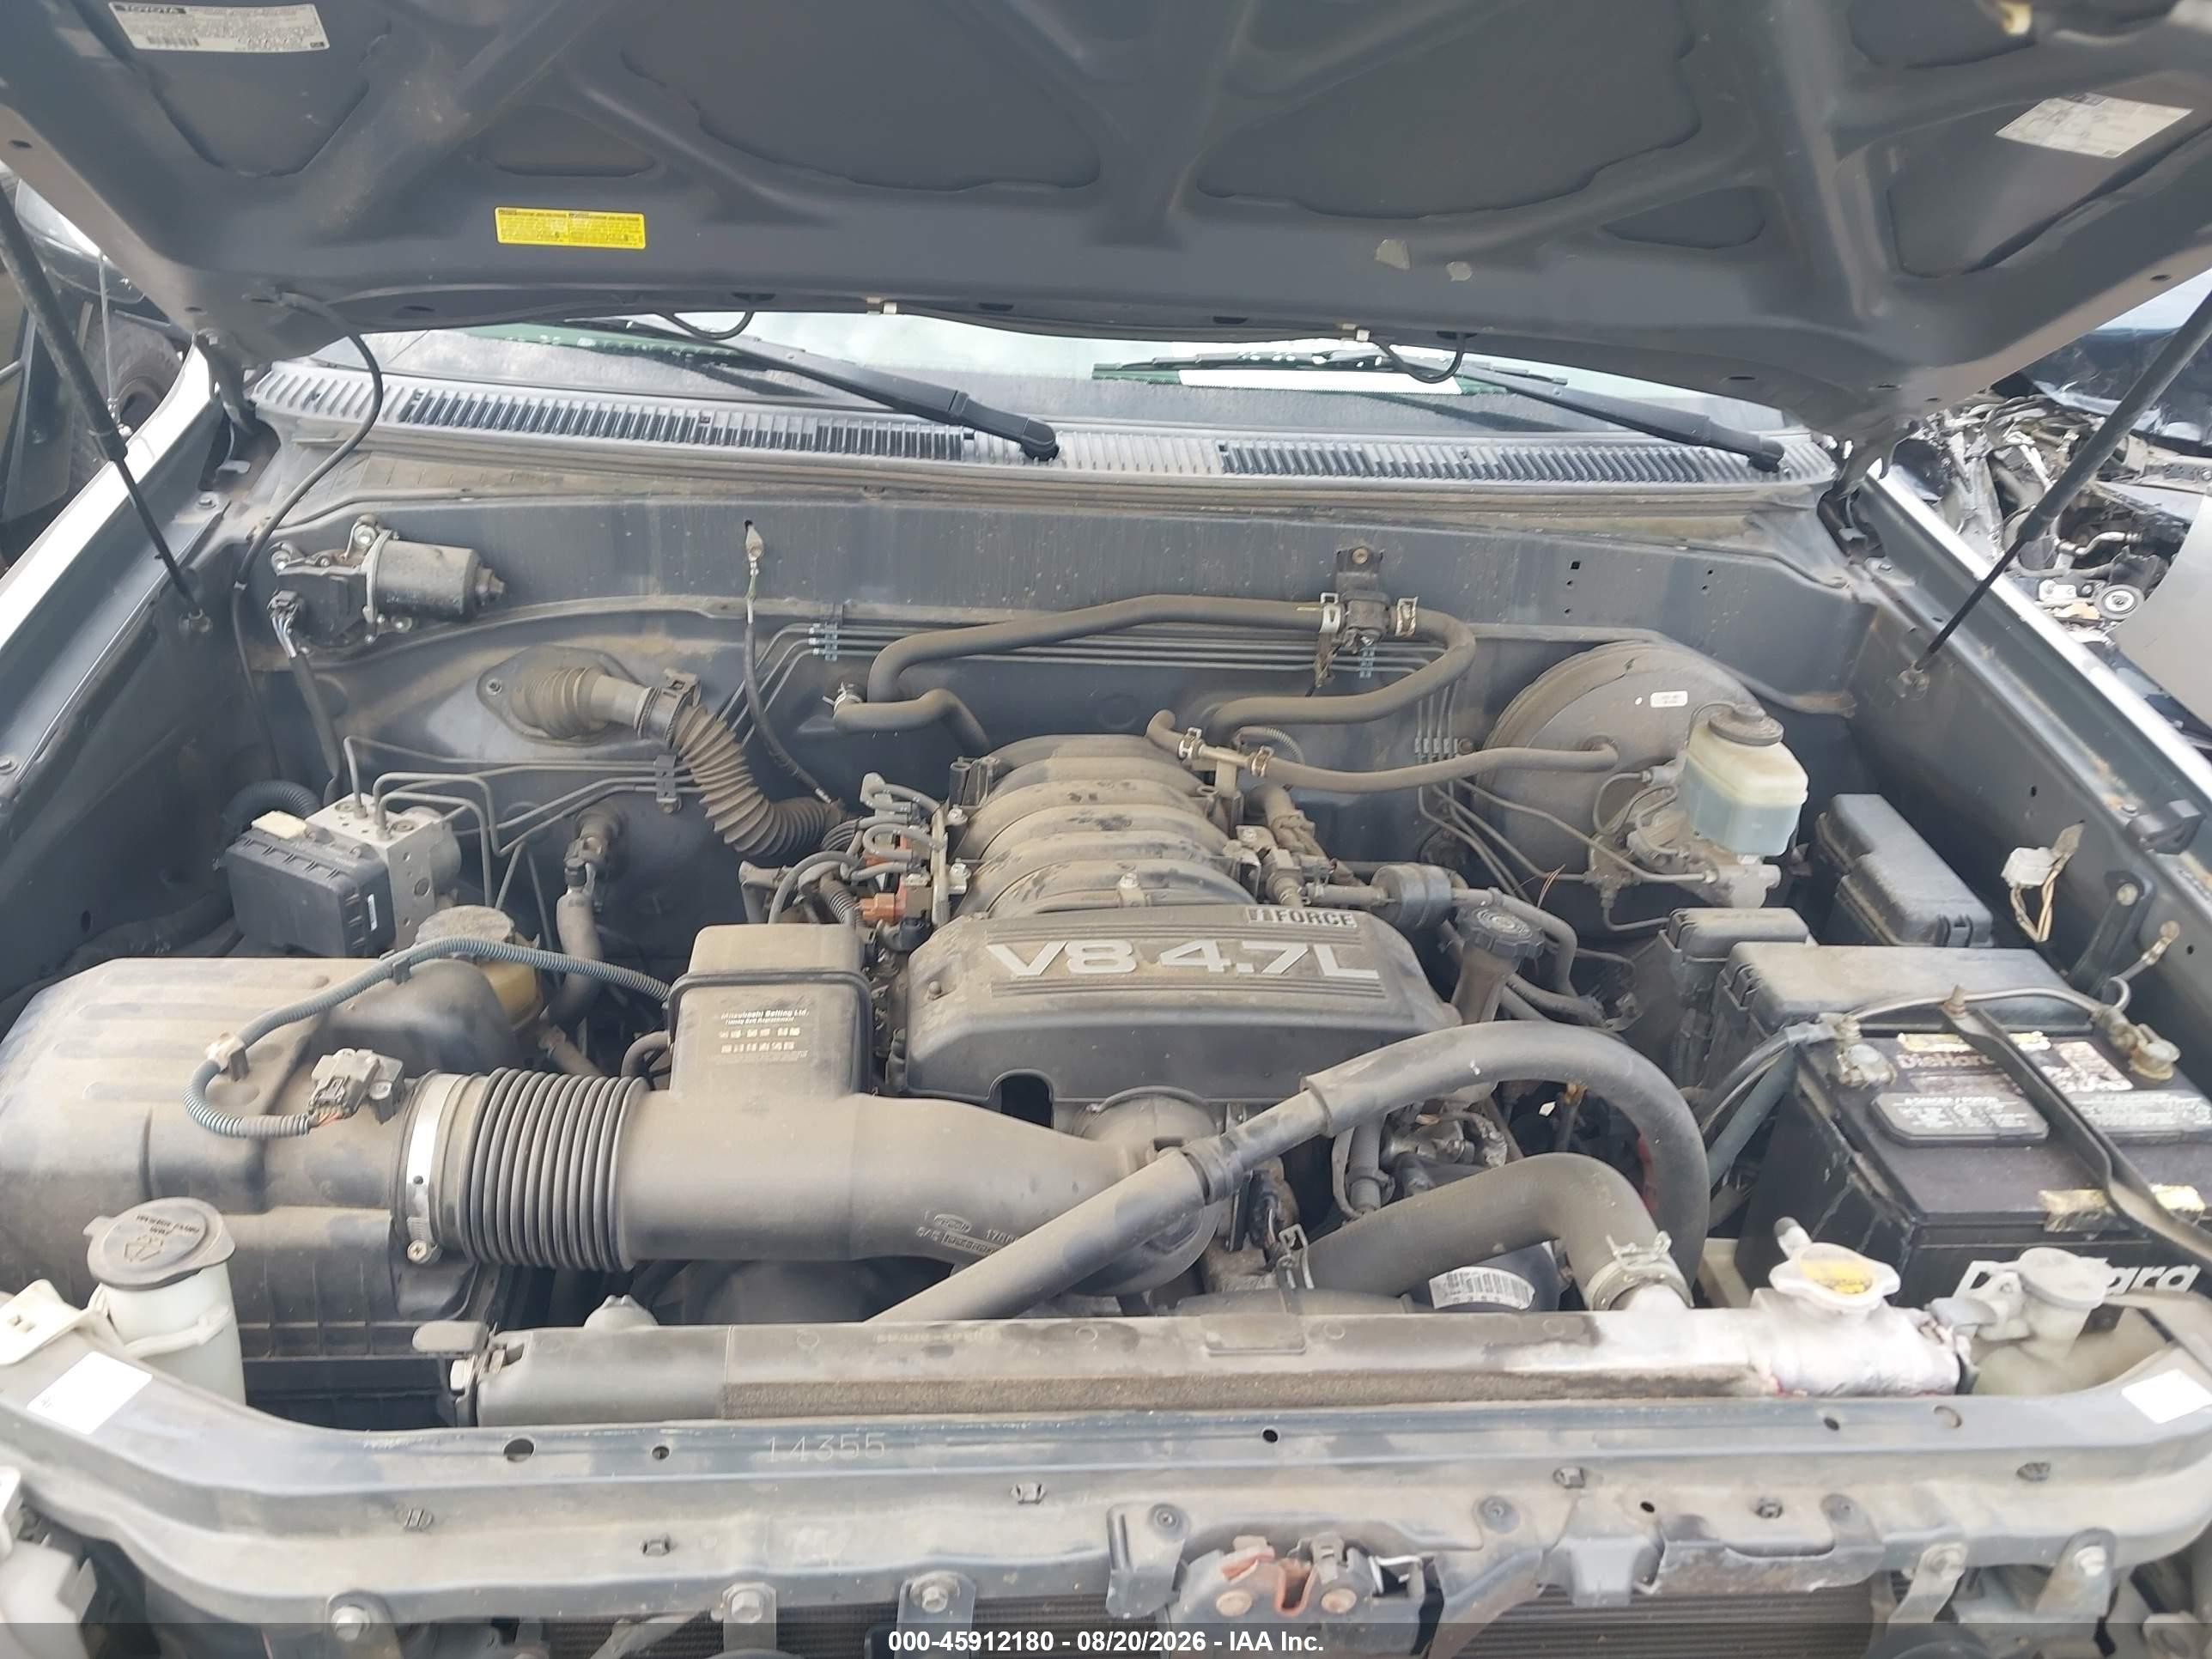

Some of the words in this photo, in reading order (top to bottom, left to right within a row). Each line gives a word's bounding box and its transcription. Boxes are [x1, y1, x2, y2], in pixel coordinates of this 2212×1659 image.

[987, 940, 1138, 978] V8
[1159, 941, 1380, 980] 4.7L
[769, 1431, 886, 1462] 14355
